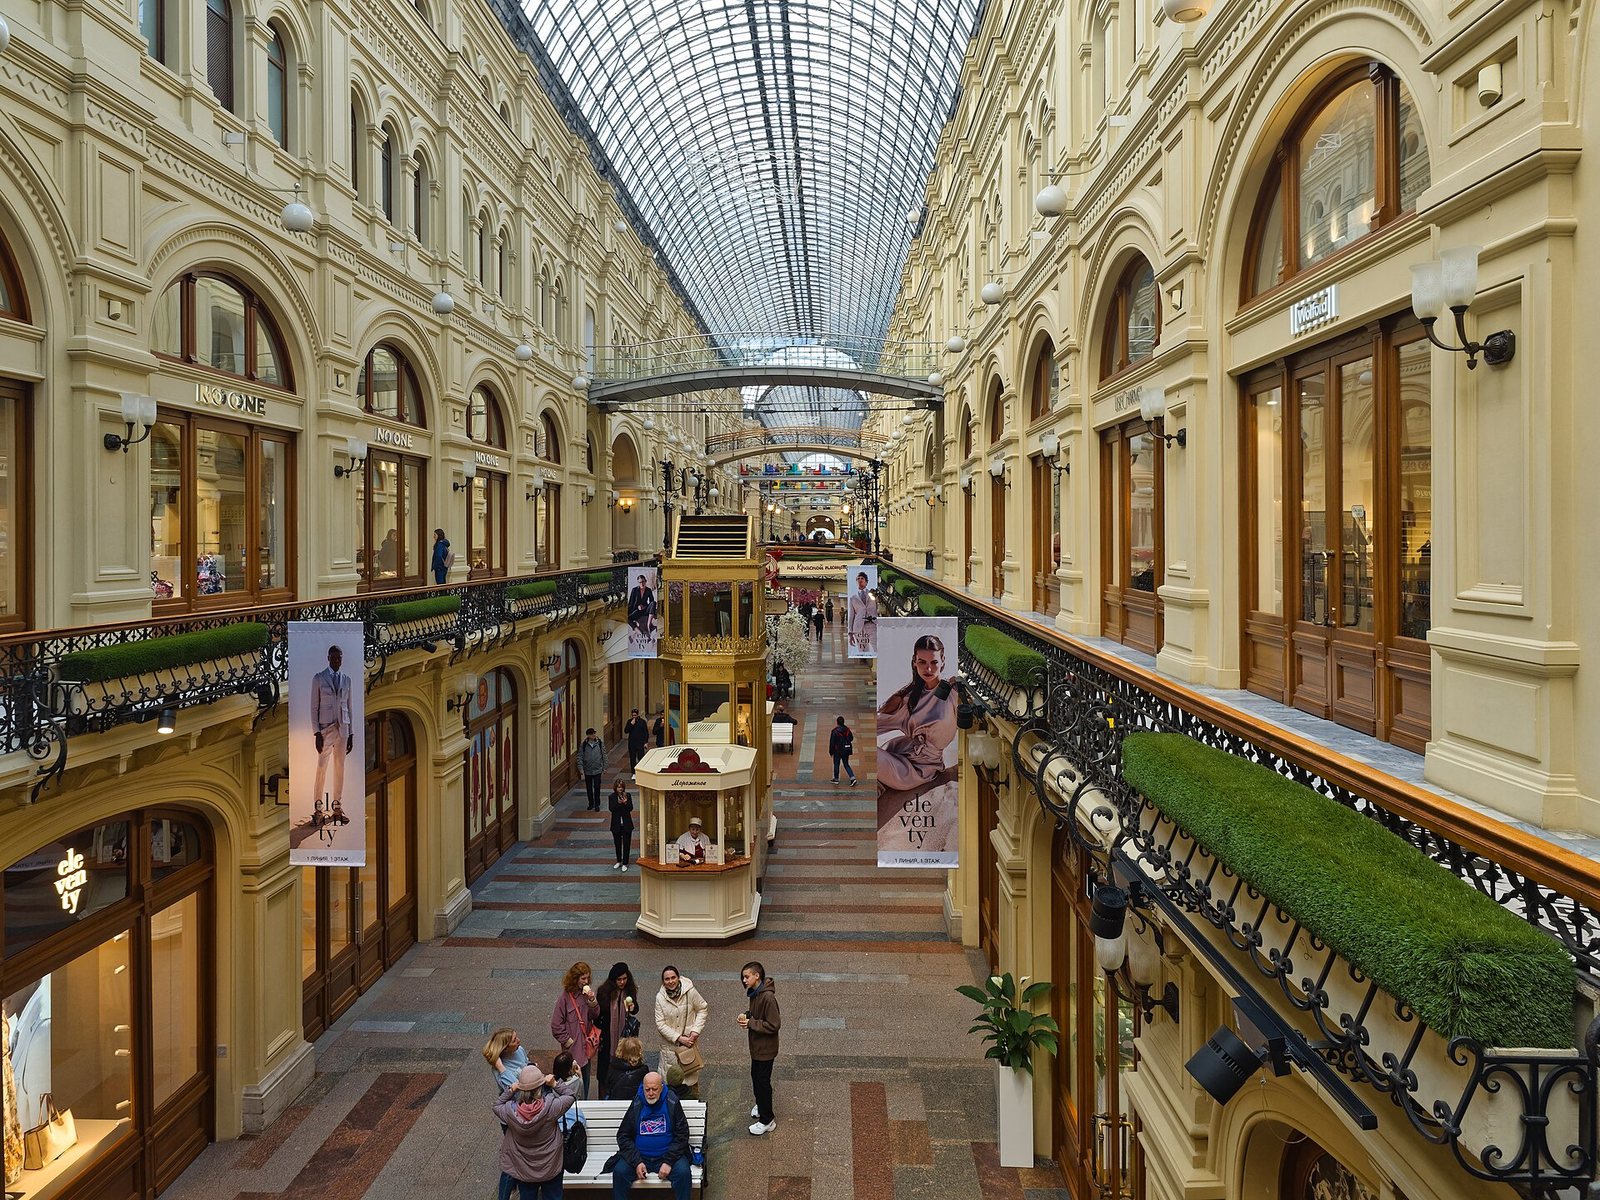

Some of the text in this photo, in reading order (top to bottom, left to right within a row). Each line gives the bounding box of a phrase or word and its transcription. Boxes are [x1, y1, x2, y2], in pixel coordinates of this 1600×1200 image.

[1297, 296, 1328, 324] Wolford
[195, 383, 267, 416] NO ONE
[374, 427, 413, 448] NO ONE
[475, 451, 499, 466] NO ONE
[796, 563, 824, 572] Красной
[314, 792, 341, 812] ele
[903, 793, 931, 813] ele
[310, 813, 344, 827] ven
[898, 814, 936, 828] ven
[319, 826, 337, 848] ty
[907, 827, 928, 849] ty
[57, 848, 84, 876] ele
[53, 869, 88, 895] ven
[60, 889, 81, 914] ty
